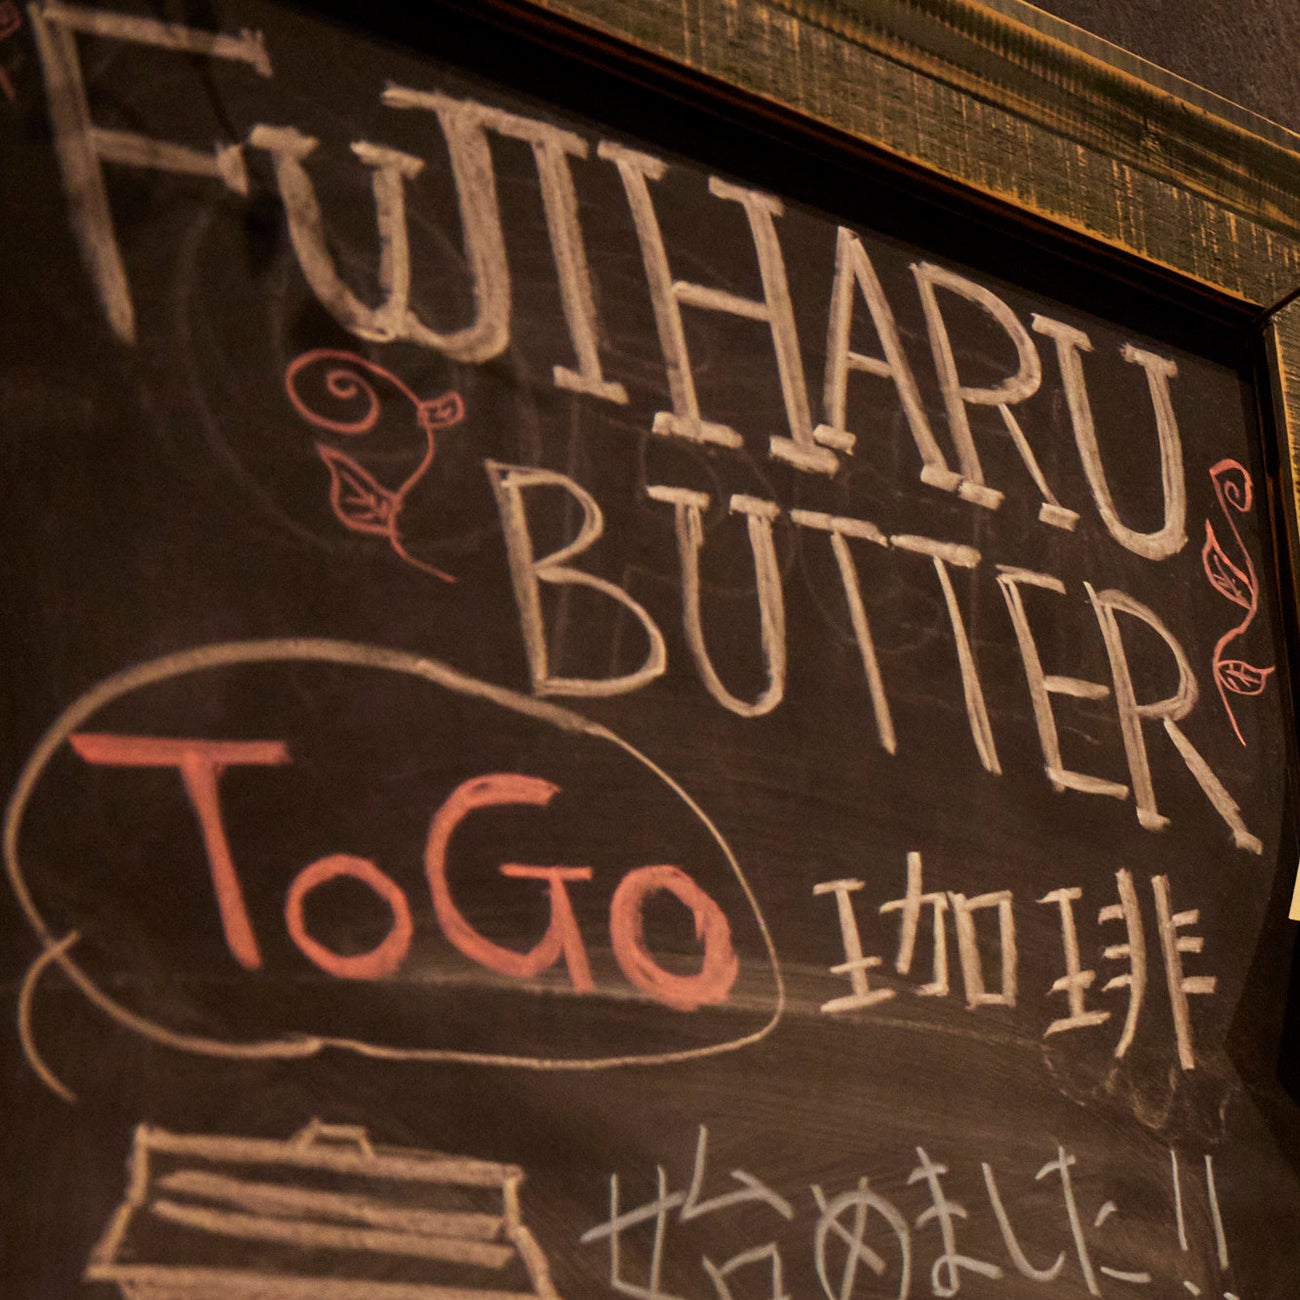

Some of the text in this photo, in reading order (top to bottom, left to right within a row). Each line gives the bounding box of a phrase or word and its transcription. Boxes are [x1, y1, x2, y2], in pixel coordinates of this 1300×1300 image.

[28, 2, 1190, 562] FUJIHARU
[485, 460, 1262, 855] BUTTER
[814, 852, 1217, 1072] 珈琲
